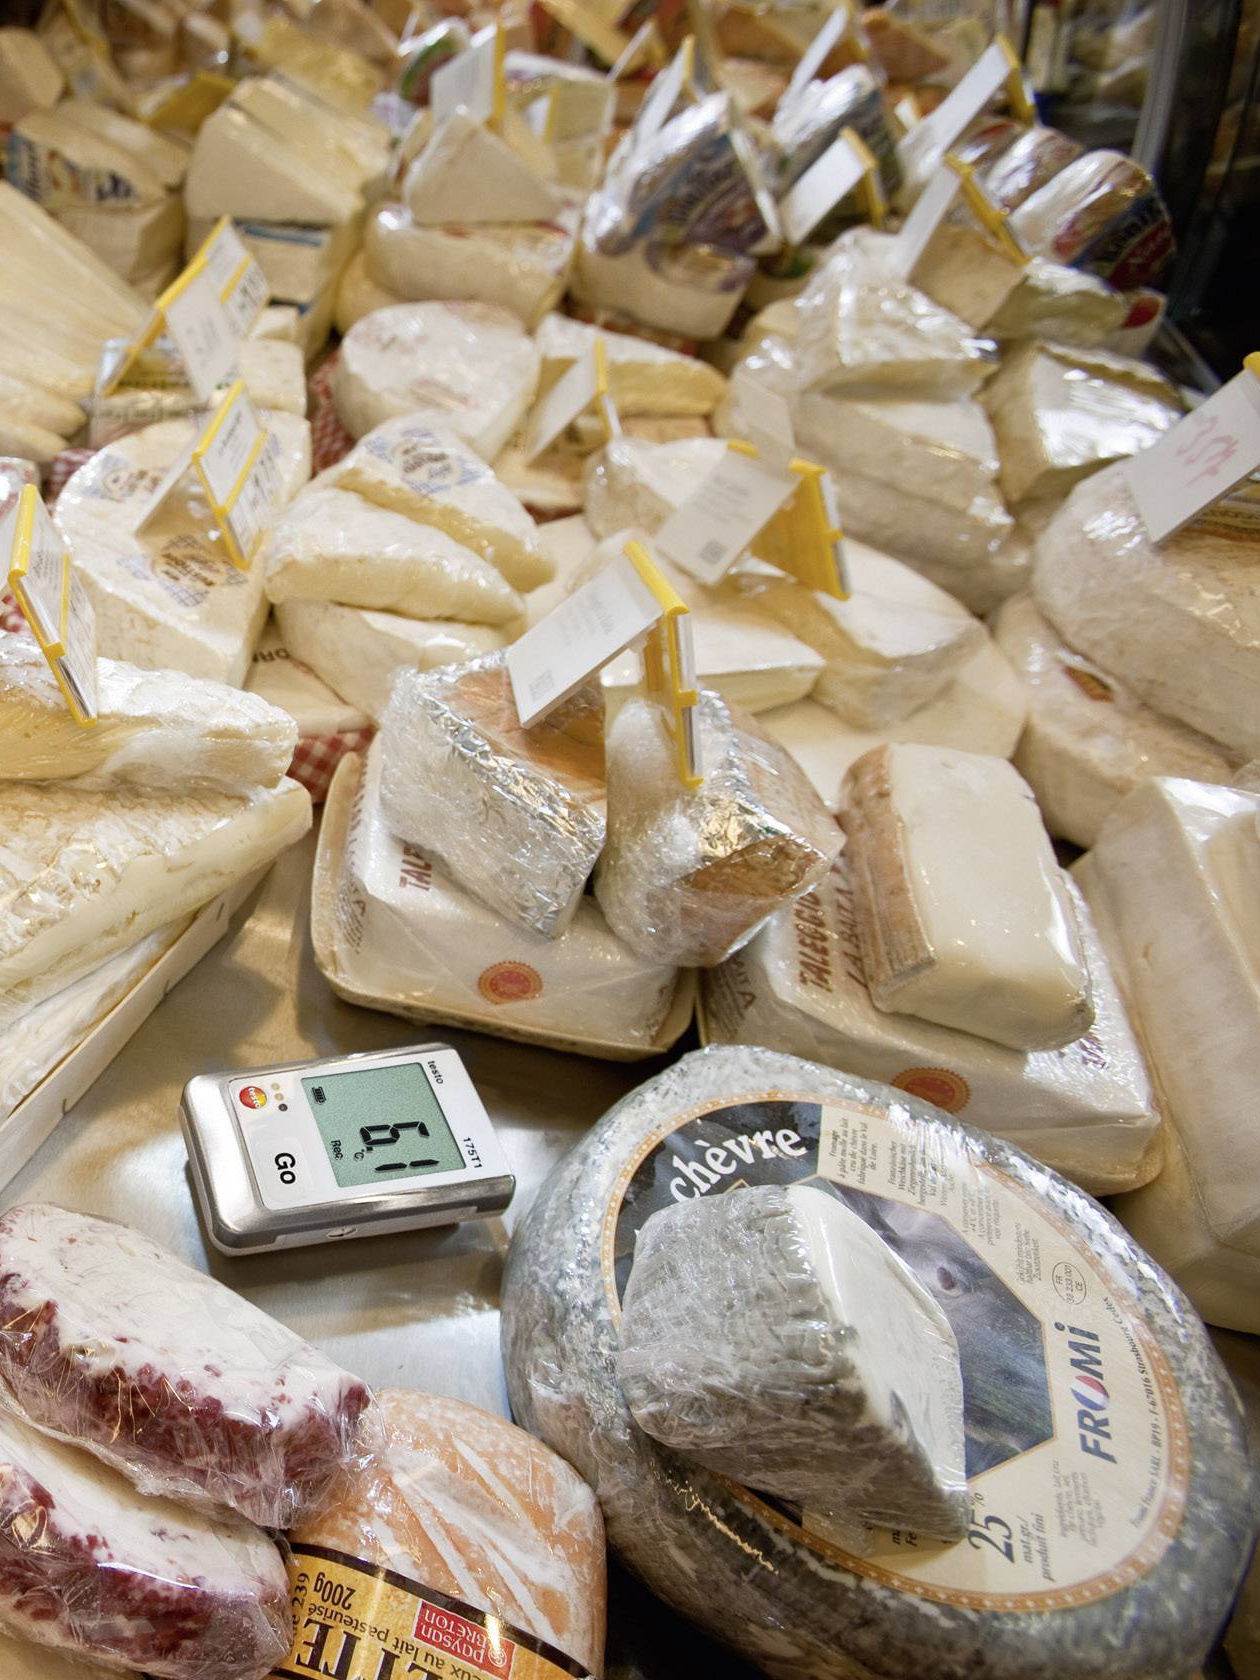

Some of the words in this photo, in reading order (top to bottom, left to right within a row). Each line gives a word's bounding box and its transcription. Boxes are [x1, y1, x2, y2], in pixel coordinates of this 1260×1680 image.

[427, 1060, 445, 1086] testo
[331, 1139, 344, 1162] Rec
[462, 1136, 483, 1169] 175T1
[669, 1128, 808, 1203] chèvre
[273, 1152, 297, 1185] Go
[291, 1572, 311, 1608] 239
[313, 1571, 357, 1611] 200g
[307, 1602, 391, 1643] pasteurisé
[392, 1636, 421, 1664] lait
[420, 1622, 486, 1664] paysan
[423, 1652, 446, 1671] au
